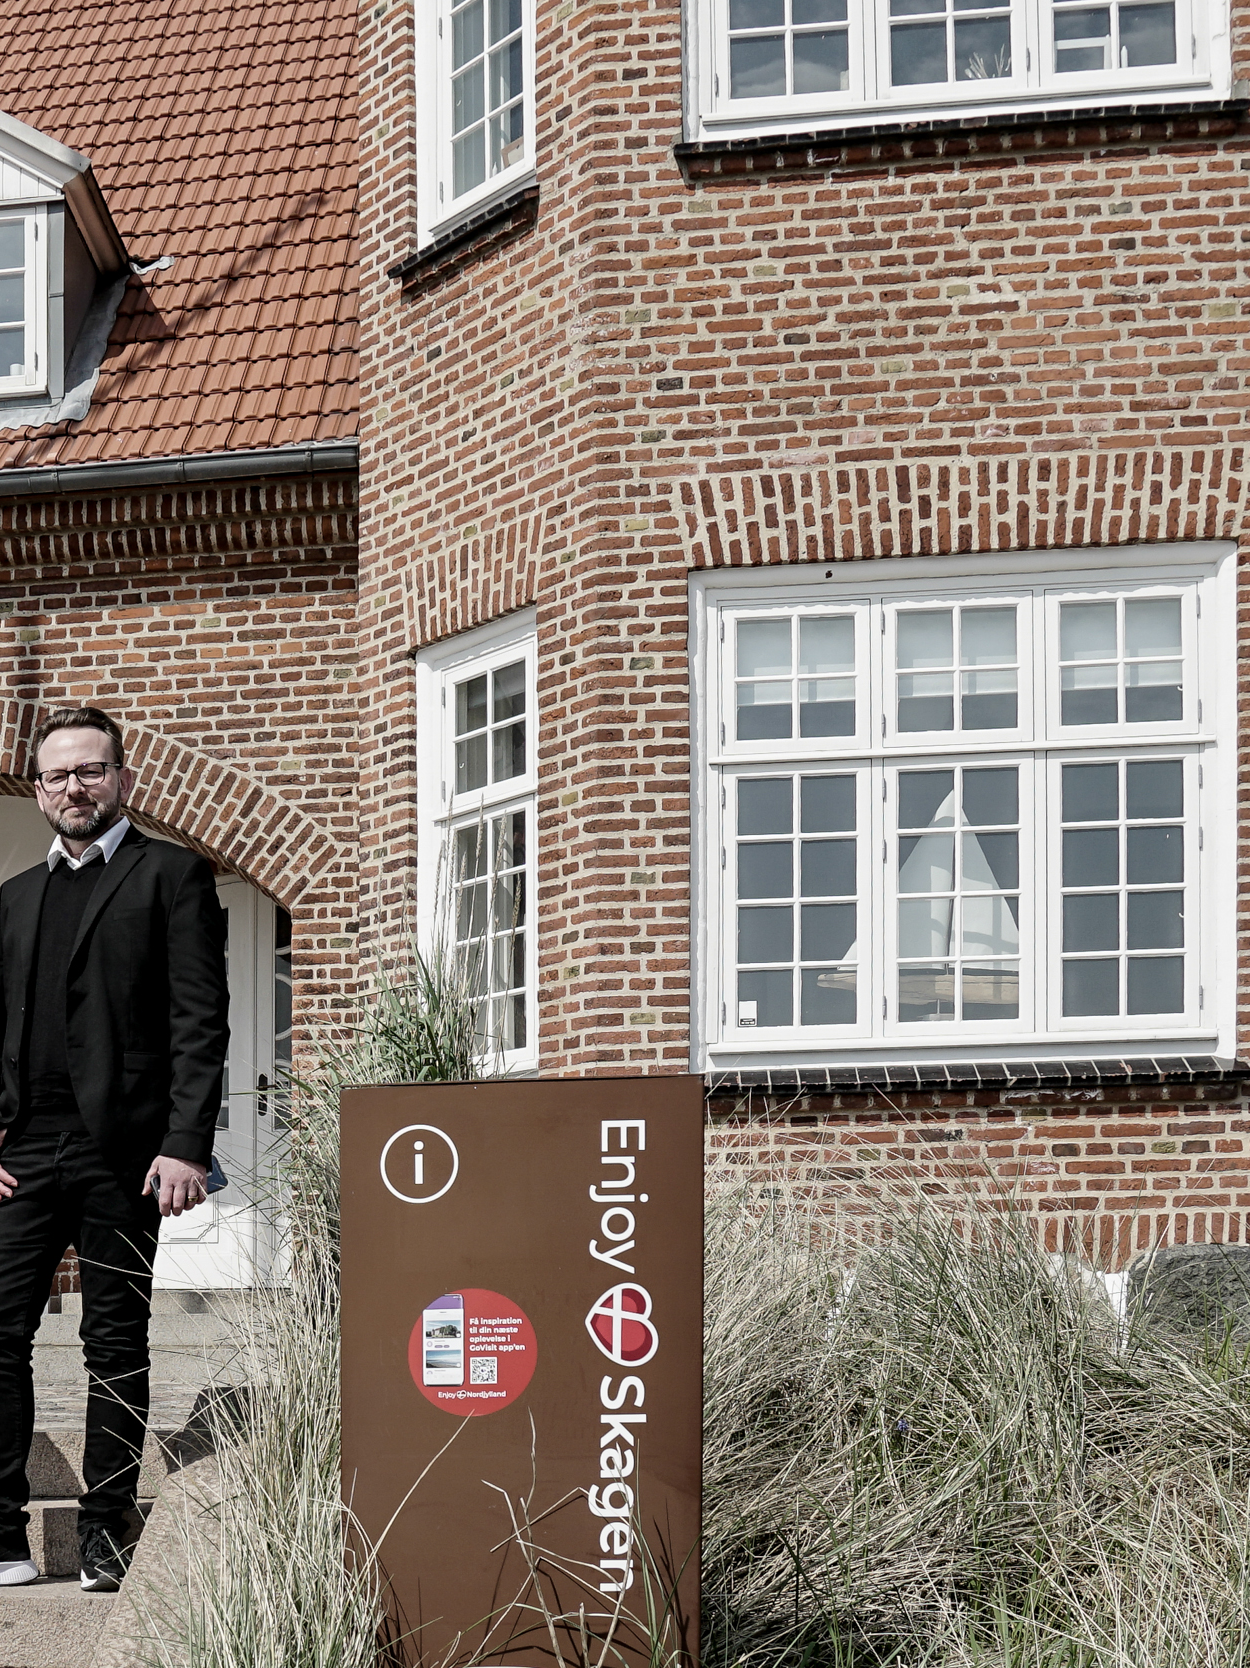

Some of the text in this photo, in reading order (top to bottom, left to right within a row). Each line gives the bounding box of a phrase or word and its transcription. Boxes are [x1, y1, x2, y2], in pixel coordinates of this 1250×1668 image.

[469, 1317, 523, 1326] Få inspiration
[469, 1326, 519, 1334] til din næste
[469, 1335, 507, 1343] oplevelse
[469, 1343, 526, 1352] GoVisit app'en
[588, 1119, 649, 1592] Enjoy Skagen
[438, 1390, 507, 1399] Enjoy Nordjylland
